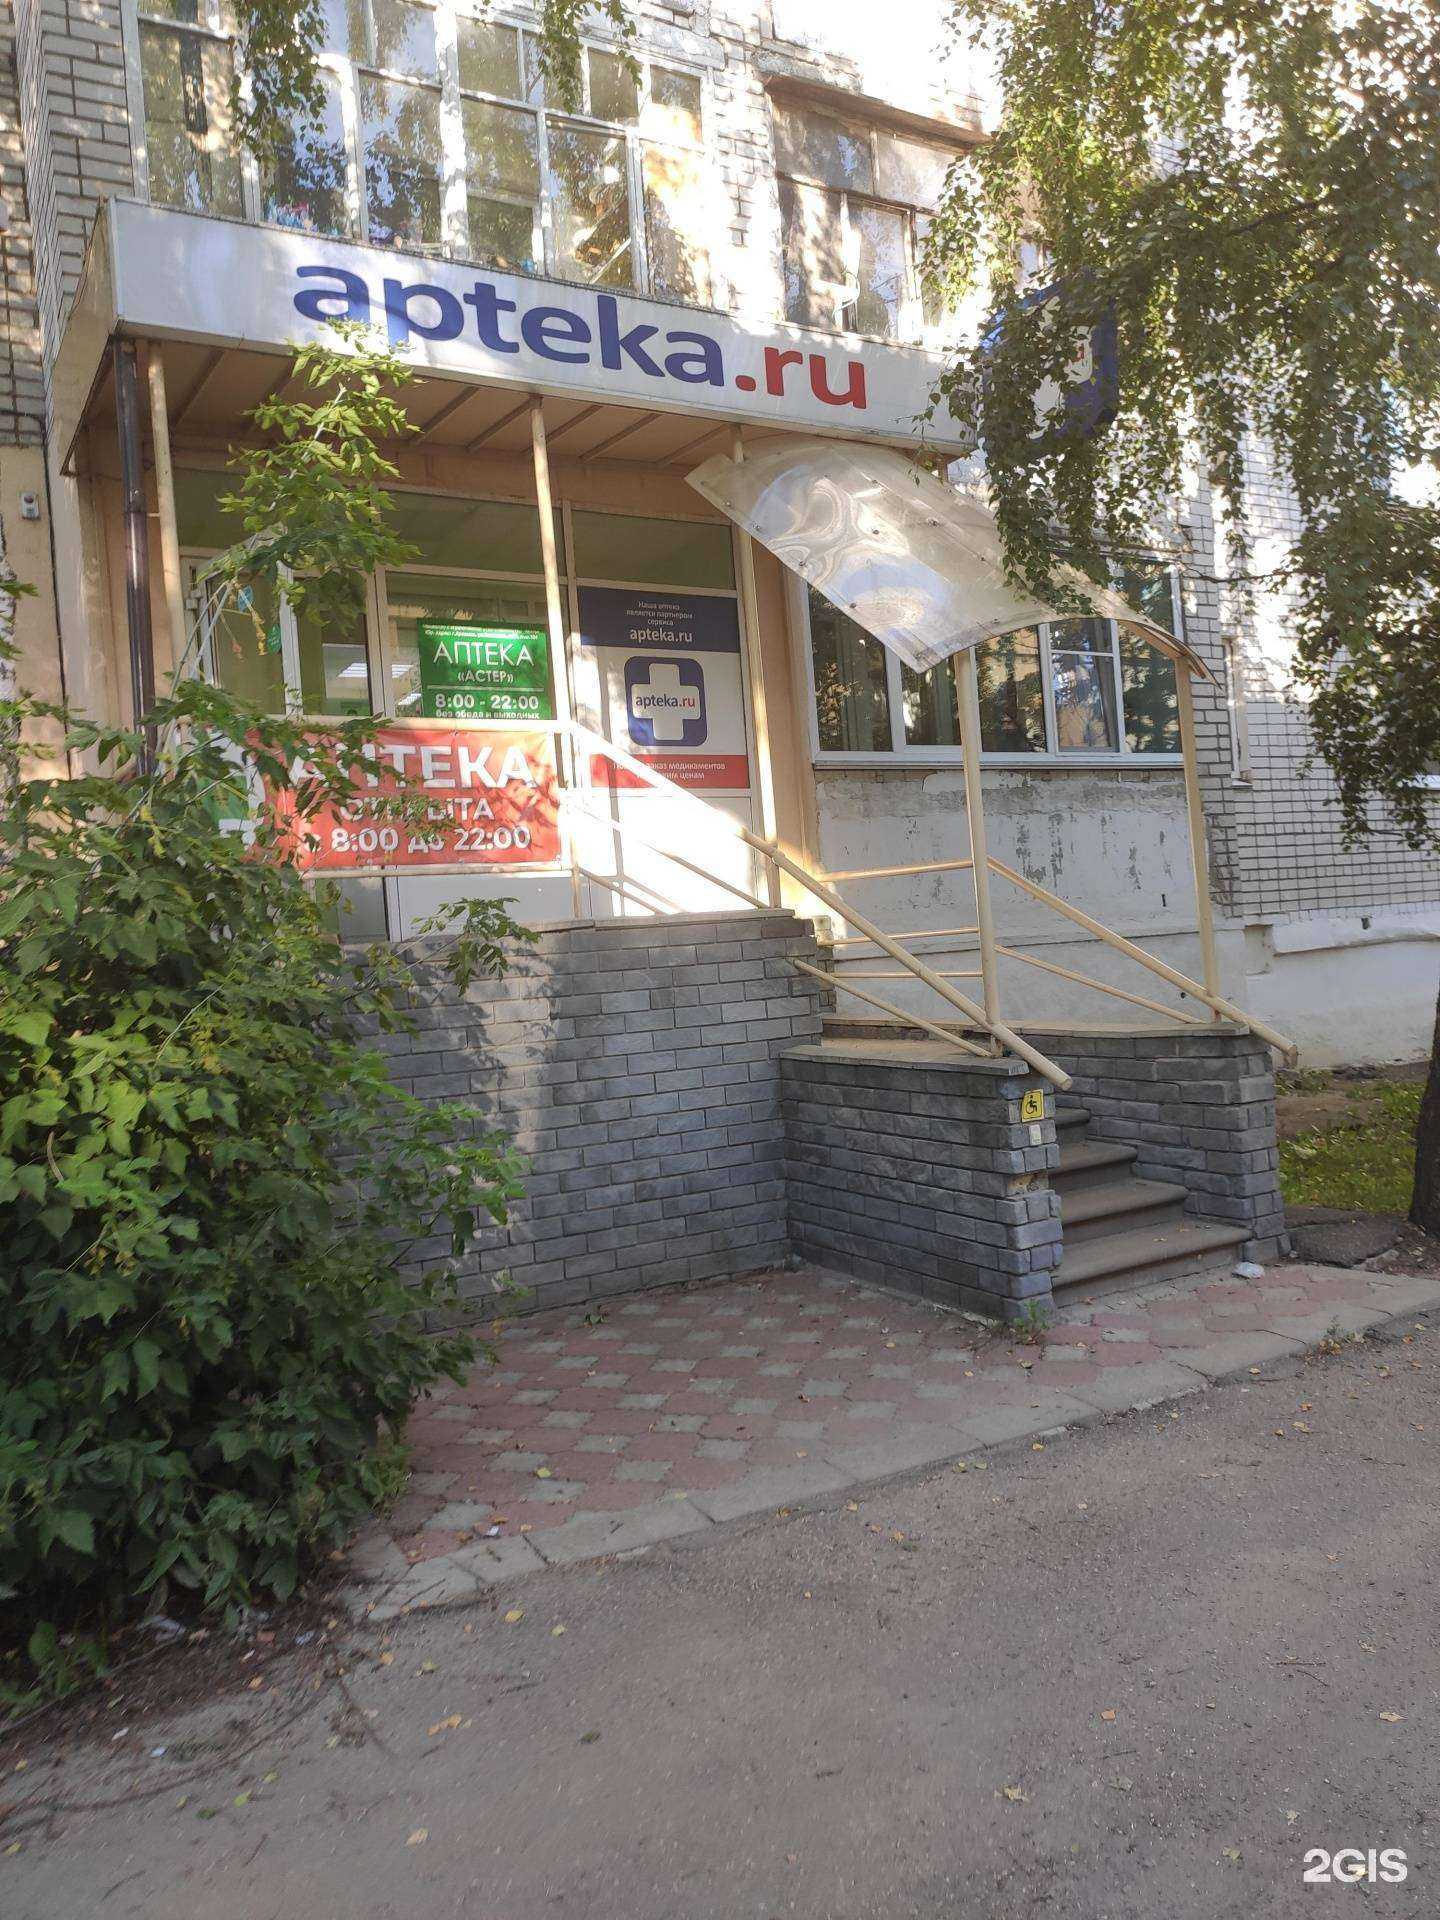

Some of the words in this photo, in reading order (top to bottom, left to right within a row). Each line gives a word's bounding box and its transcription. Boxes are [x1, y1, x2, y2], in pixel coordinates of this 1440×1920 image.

[293, 264, 867, 410] apteka.ru
[630, 627, 693, 643] apteka.ru
[433, 640, 535, 667] АПТЕКА
[457, 669, 514, 684] «АСТЕР»
[435, 692, 475, 708] 8:00
[490, 694, 539, 710] 22:00
[635, 693, 696, 709] apteka.ru
[331, 827, 399, 853] 8:00
[454, 826, 532, 851] 22:00
